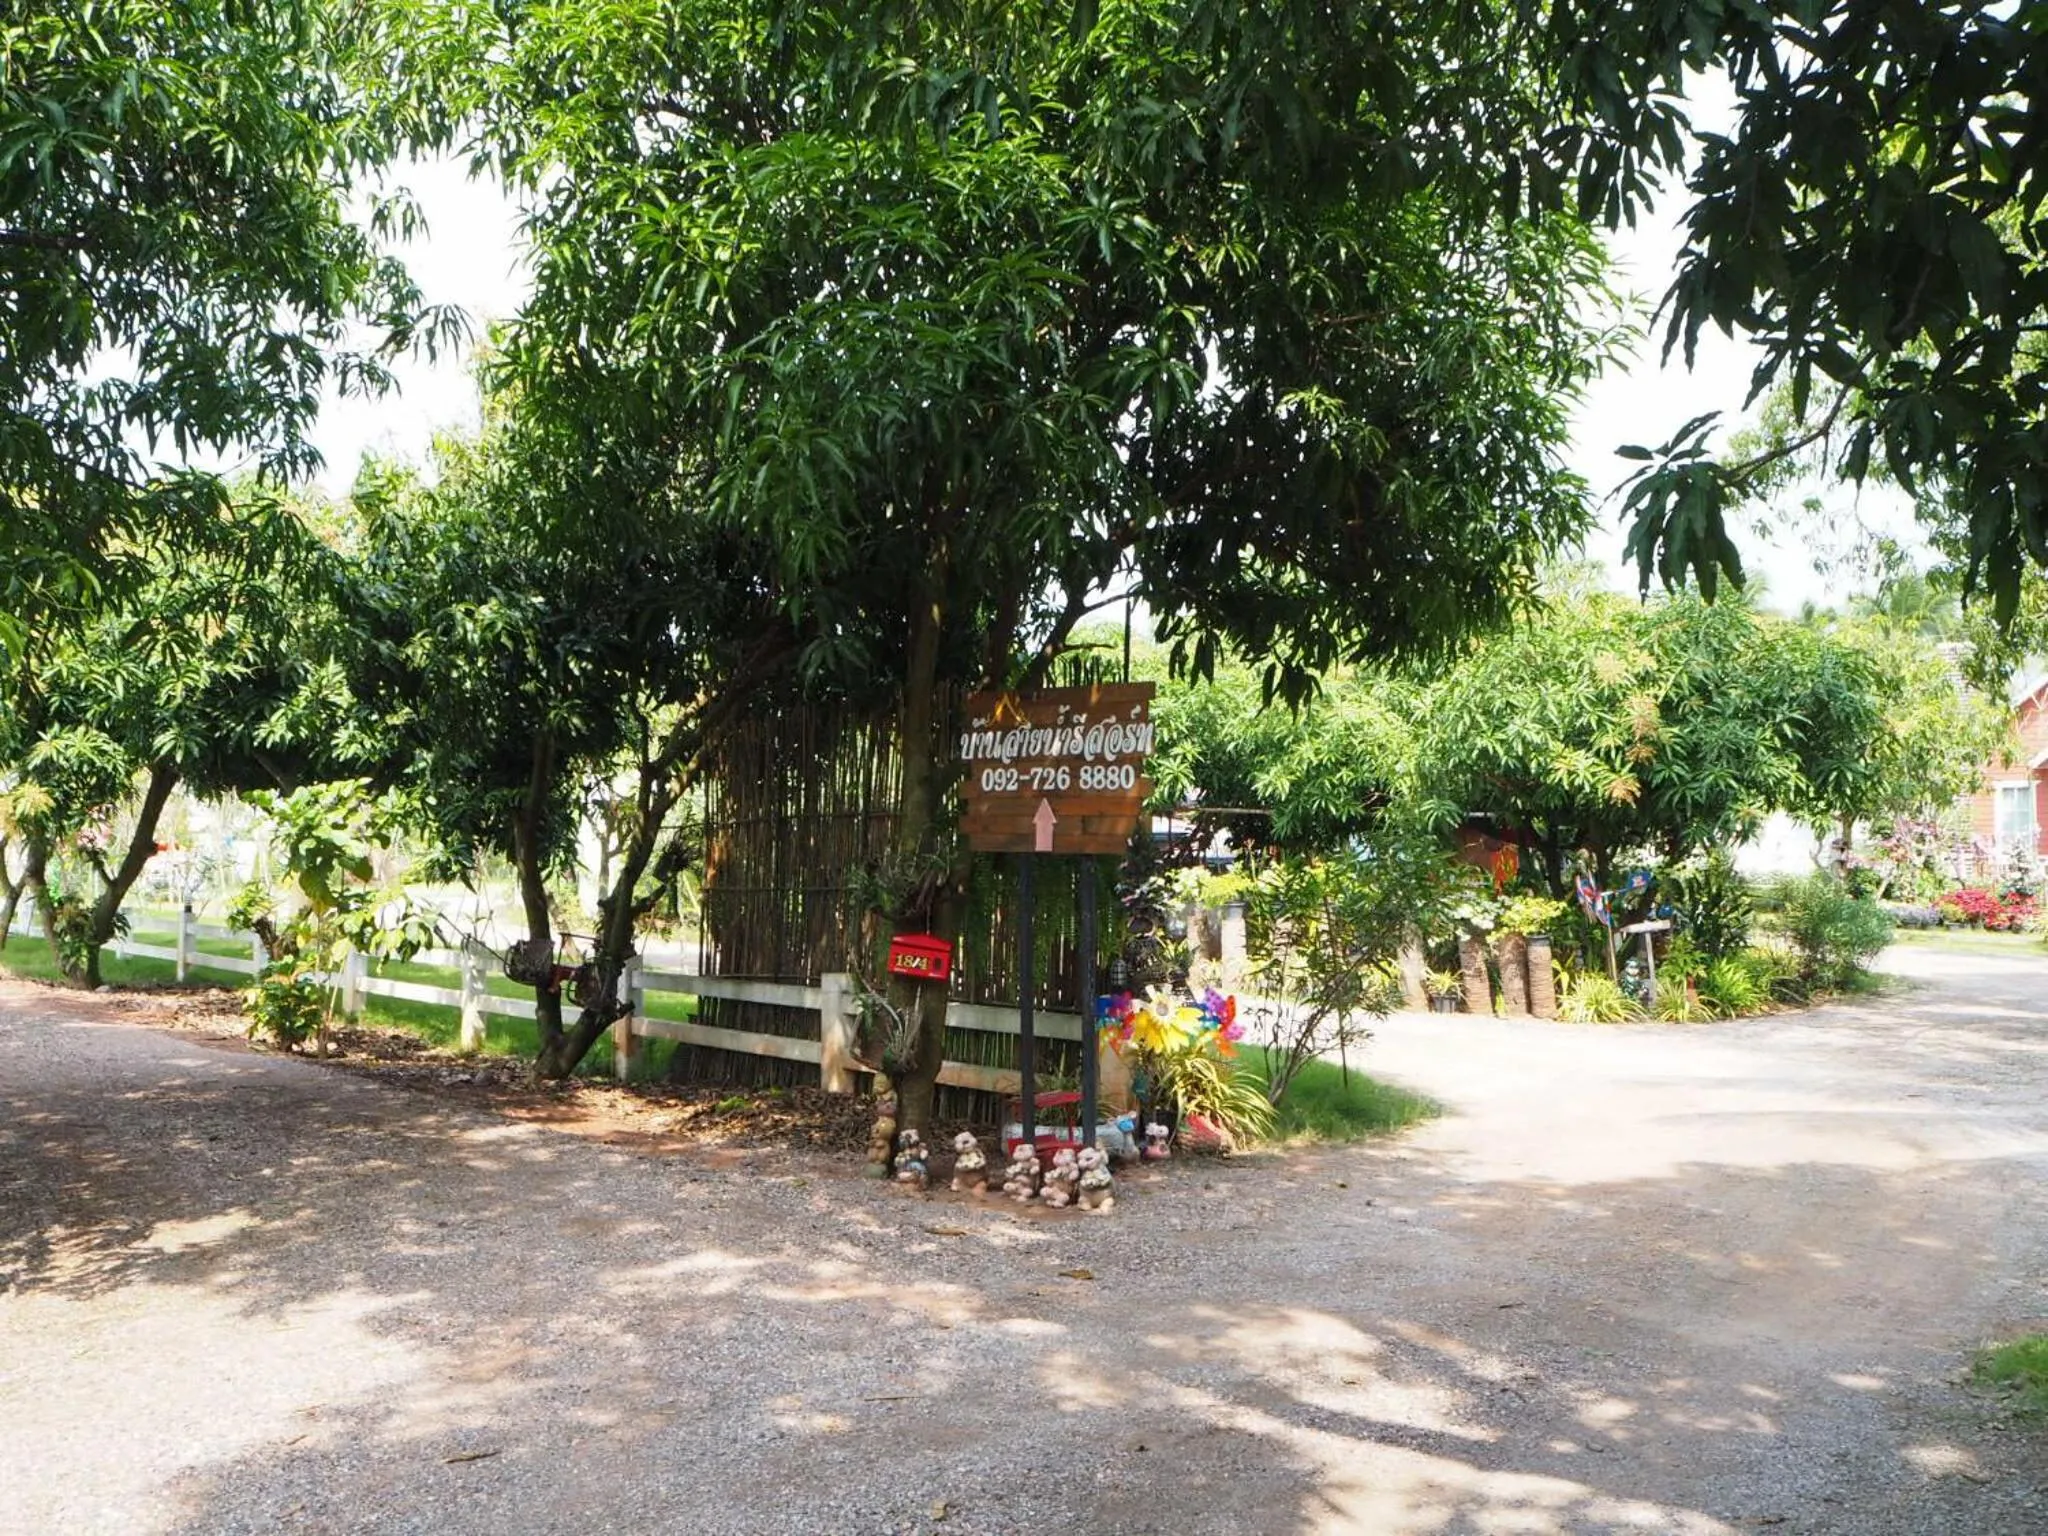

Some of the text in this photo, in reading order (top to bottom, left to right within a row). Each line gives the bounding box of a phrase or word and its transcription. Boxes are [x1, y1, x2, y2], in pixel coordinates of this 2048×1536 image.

[960, 704, 1155, 764] บ้านสายน้ำรีสอร์ท
[981, 764, 1136, 792] 092-726 8880
[896, 954, 928, 970] 18/4
